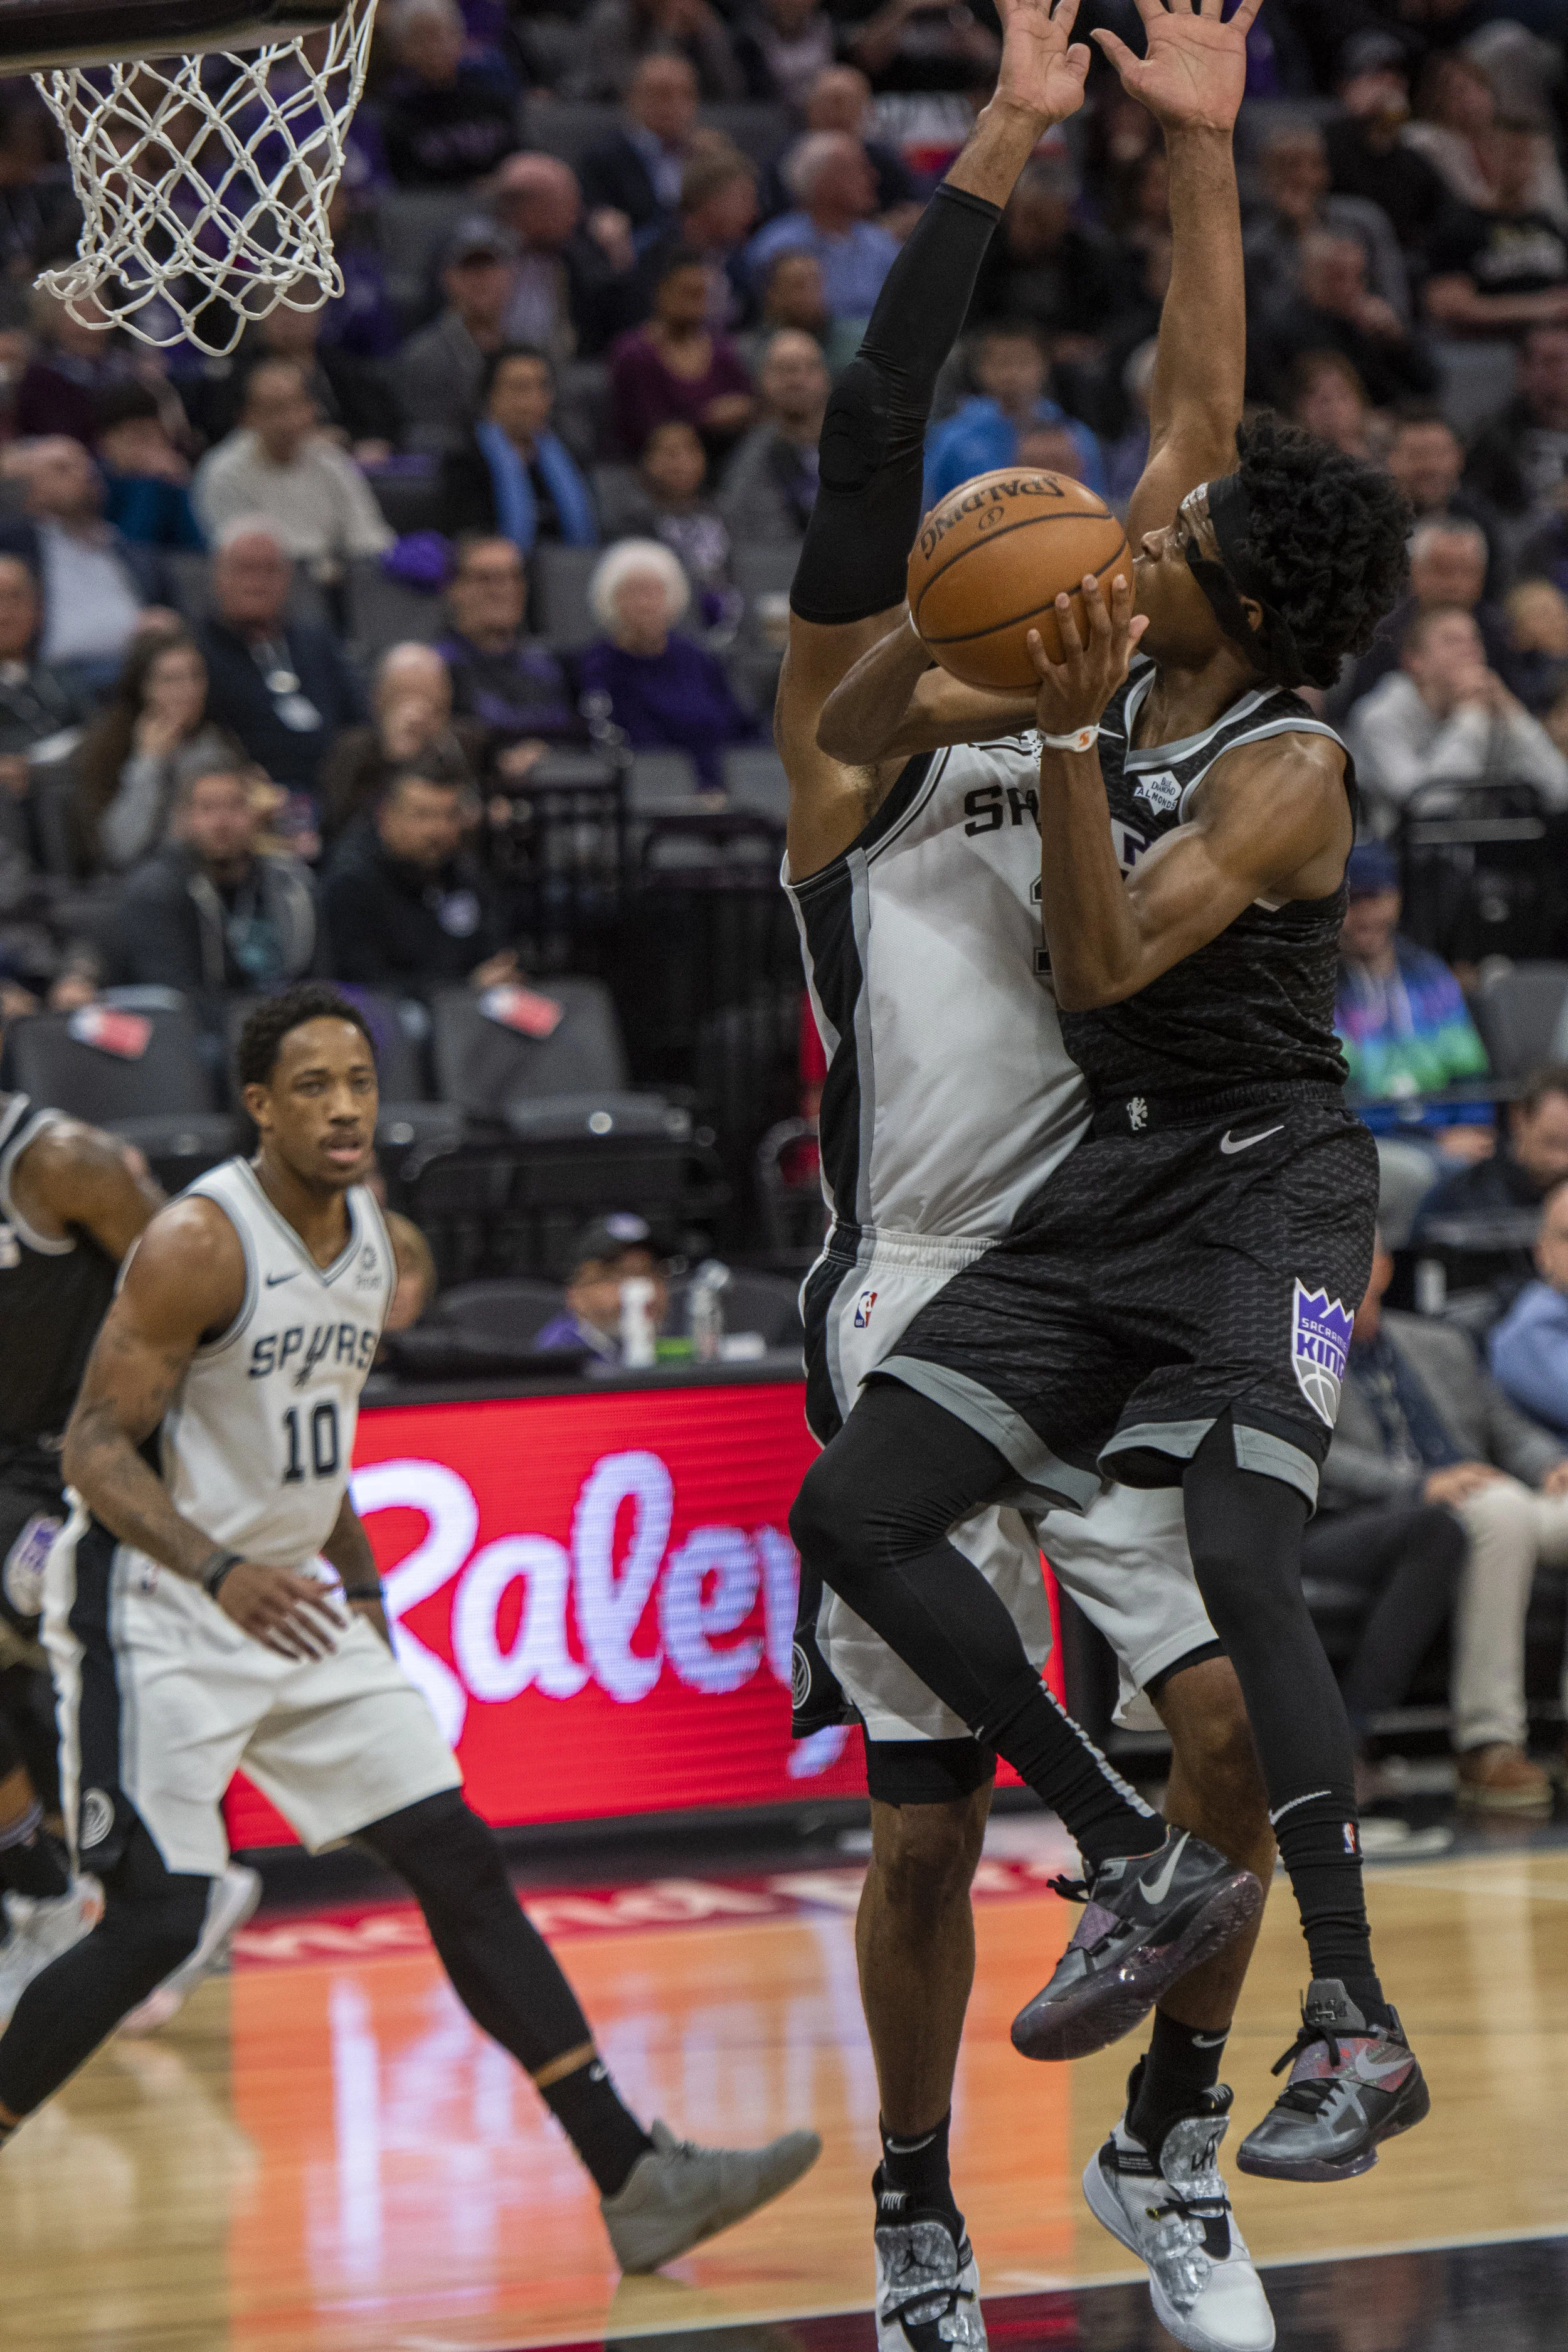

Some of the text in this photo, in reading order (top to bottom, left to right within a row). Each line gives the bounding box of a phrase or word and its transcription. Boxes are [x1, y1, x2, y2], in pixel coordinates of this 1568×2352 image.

[920, 474, 1064, 560] SPALDING
[1137, 787, 1175, 809] ALMONDS
[1151, 781, 1176, 795] DIAMOND
[248, 1323, 378, 1387] SPURS
[282, 1401, 339, 1485] 10
